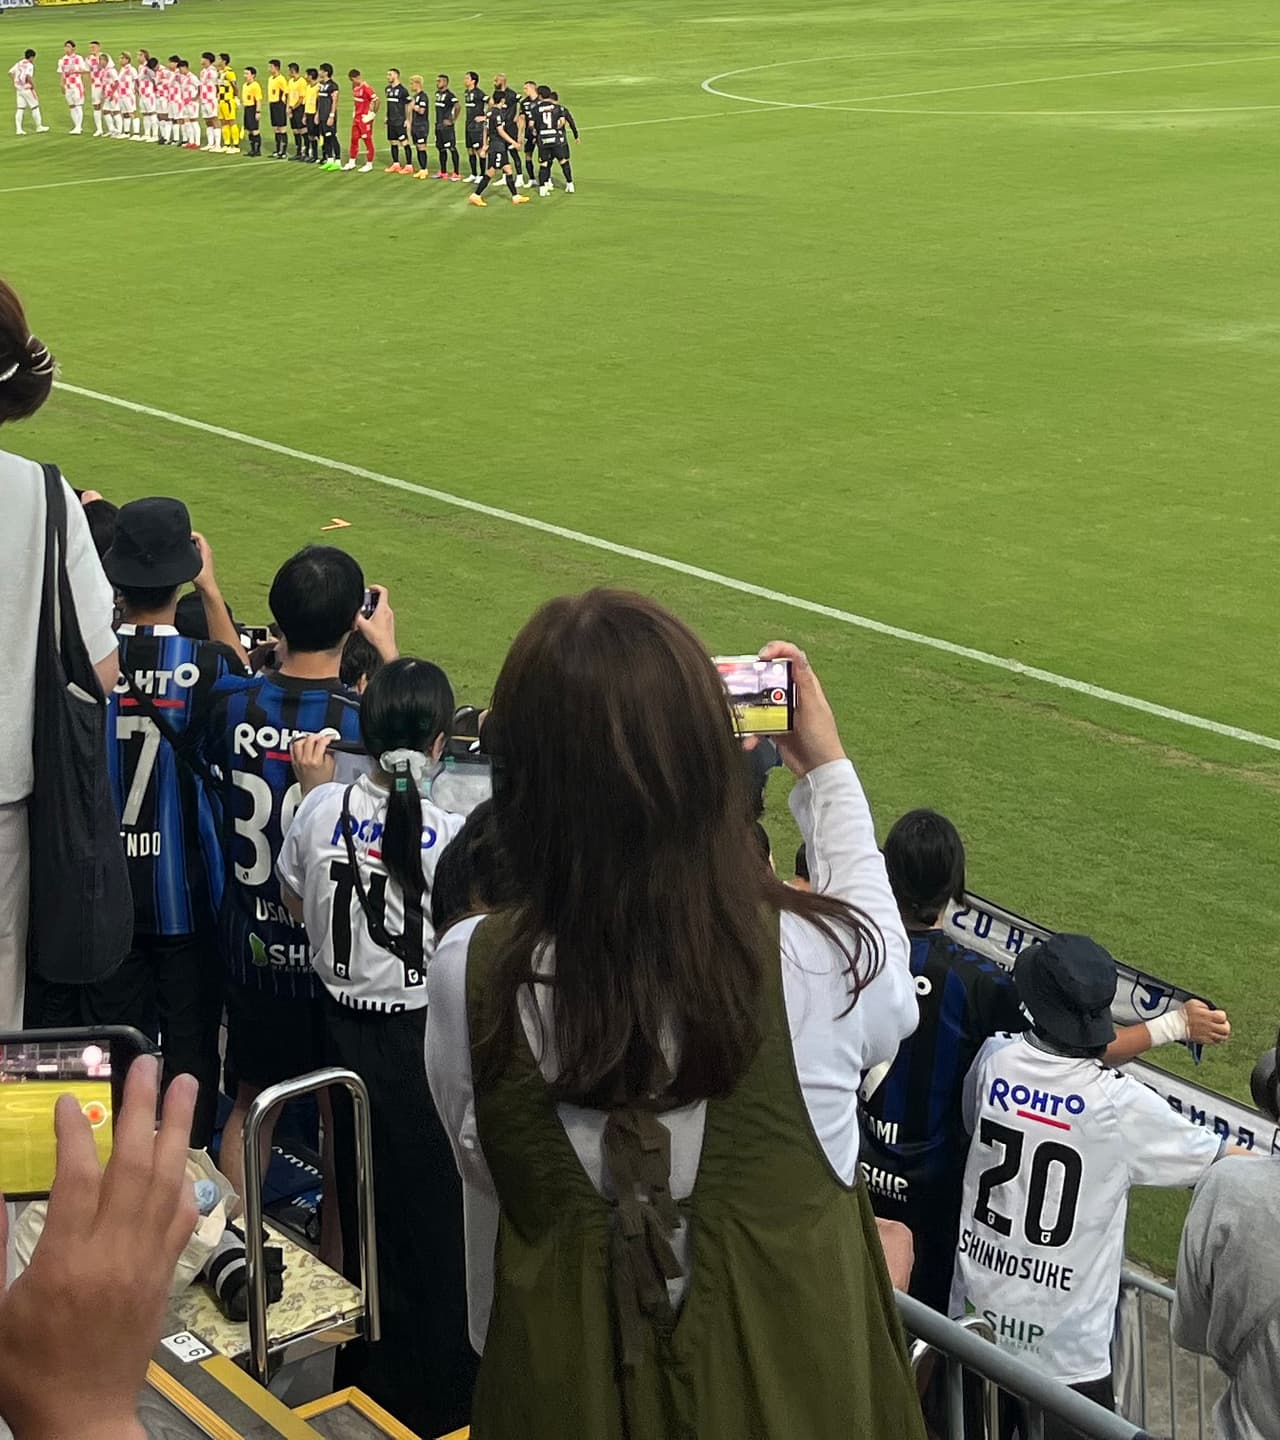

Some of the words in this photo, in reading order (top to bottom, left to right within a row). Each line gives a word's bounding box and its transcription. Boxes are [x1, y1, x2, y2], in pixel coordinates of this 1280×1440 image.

[113, 663, 200, 695] OHTO
[116, 714, 161, 826] 7
[121, 831, 161, 857] NDO
[331, 814, 438, 852] ROO
[255, 896, 305, 929] USA
[988, 1077, 1086, 1115] ROHTO
[863, 1112, 899, 1145] AMI
[860, 1162, 910, 1194] SHIP
[973, 1117, 1084, 1248] 20
[958, 1228, 1074, 1292] SHINNOSUKE
[982, 1309, 1045, 1344] SHIP
